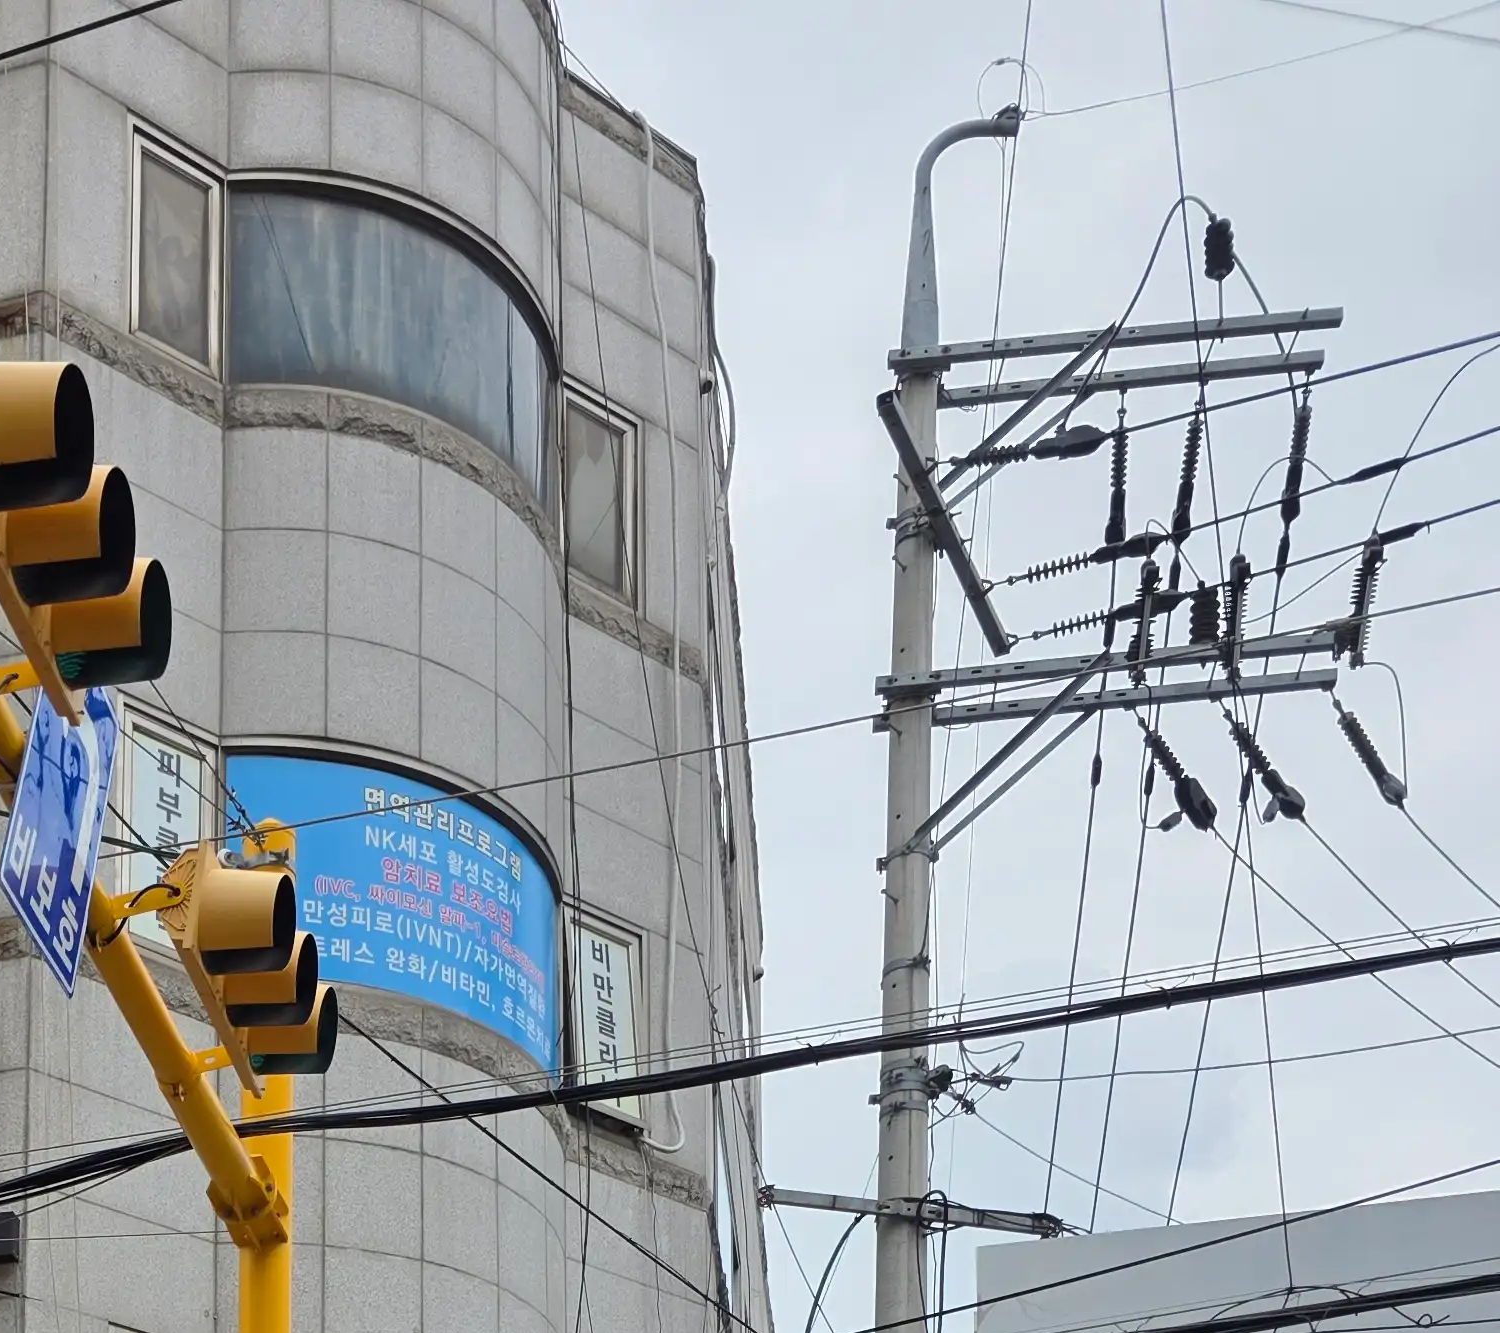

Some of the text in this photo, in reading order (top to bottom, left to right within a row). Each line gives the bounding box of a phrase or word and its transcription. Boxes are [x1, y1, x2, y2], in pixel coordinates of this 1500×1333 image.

[363, 786, 522, 883] 면역관리프로그램
[365, 825, 521, 915] NK세포 활성도검사
[9, 814, 77, 973] 비보호
[381, 857, 512, 937] 암치료 보조요법
